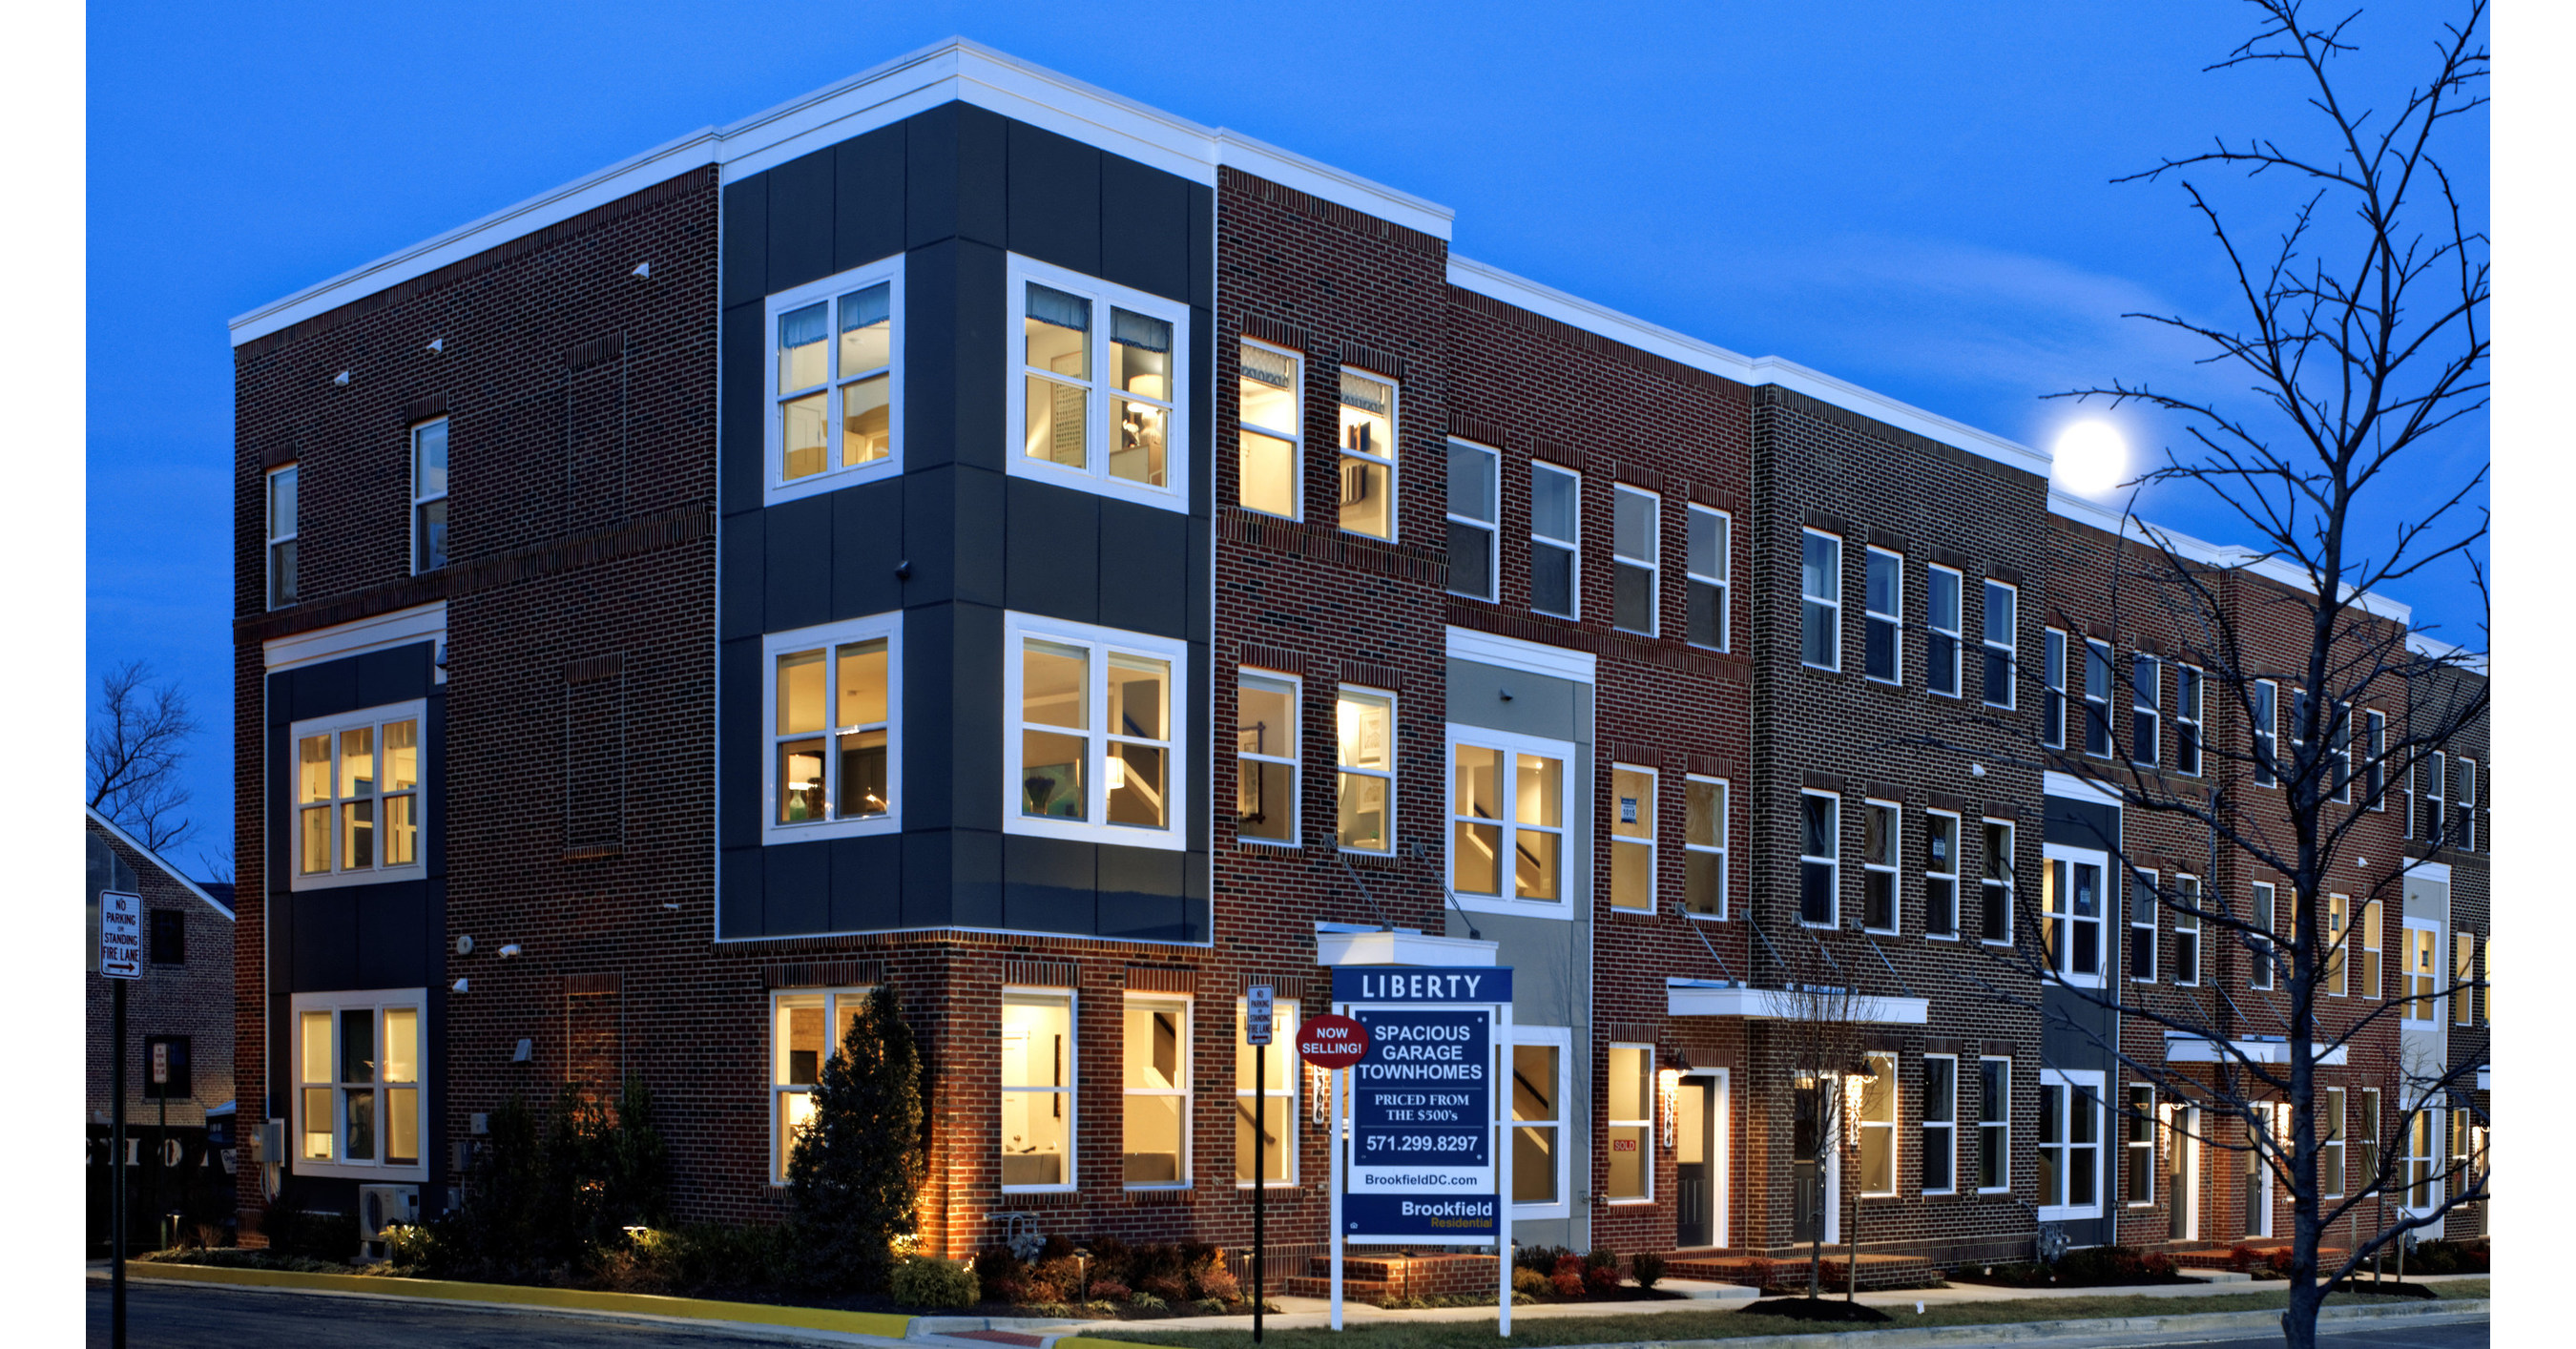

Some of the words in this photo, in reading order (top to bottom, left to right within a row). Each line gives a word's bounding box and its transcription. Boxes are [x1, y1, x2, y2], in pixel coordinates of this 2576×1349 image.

[115, 900, 126, 911] NO
[106, 912, 135, 925] PARKING
[104, 932, 137, 946] STANDING
[103, 946, 117, 961] FIRE
[120, 948, 139, 963] LANE
[1361, 974, 1482, 998] LIBERTY
[1257, 990, 1264, 999] NO
[1250, 1014, 1271, 1023] STANDING
[1249, 1024, 1258, 1033] FIRE
[1259, 1023, 1272, 1033] LANE
[1317, 1027, 1348, 1039] NOW
[1375, 1026, 1470, 1041] SPACIOUS
[1302, 1043, 1361, 1054] SELLING!
[1382, 1045, 1463, 1061] GARAGE
[1359, 1064, 1483, 1080] TOWNHOMES
[1375, 1094, 1426, 1106] PRICED
[1429, 1094, 1469, 1106] FROM
[1386, 1110, 1415, 1121] THE
[1418, 1110, 1459, 1122] $500's
[1366, 1135, 1478, 1152] 571.299.8297
[1614, 1141, 1635, 1151] SOLD
[1365, 1174, 1478, 1185] BrookfieldDC.com
[1402, 1201, 1493, 1216] Brookfield
[1431, 1217, 1493, 1228] Residential
